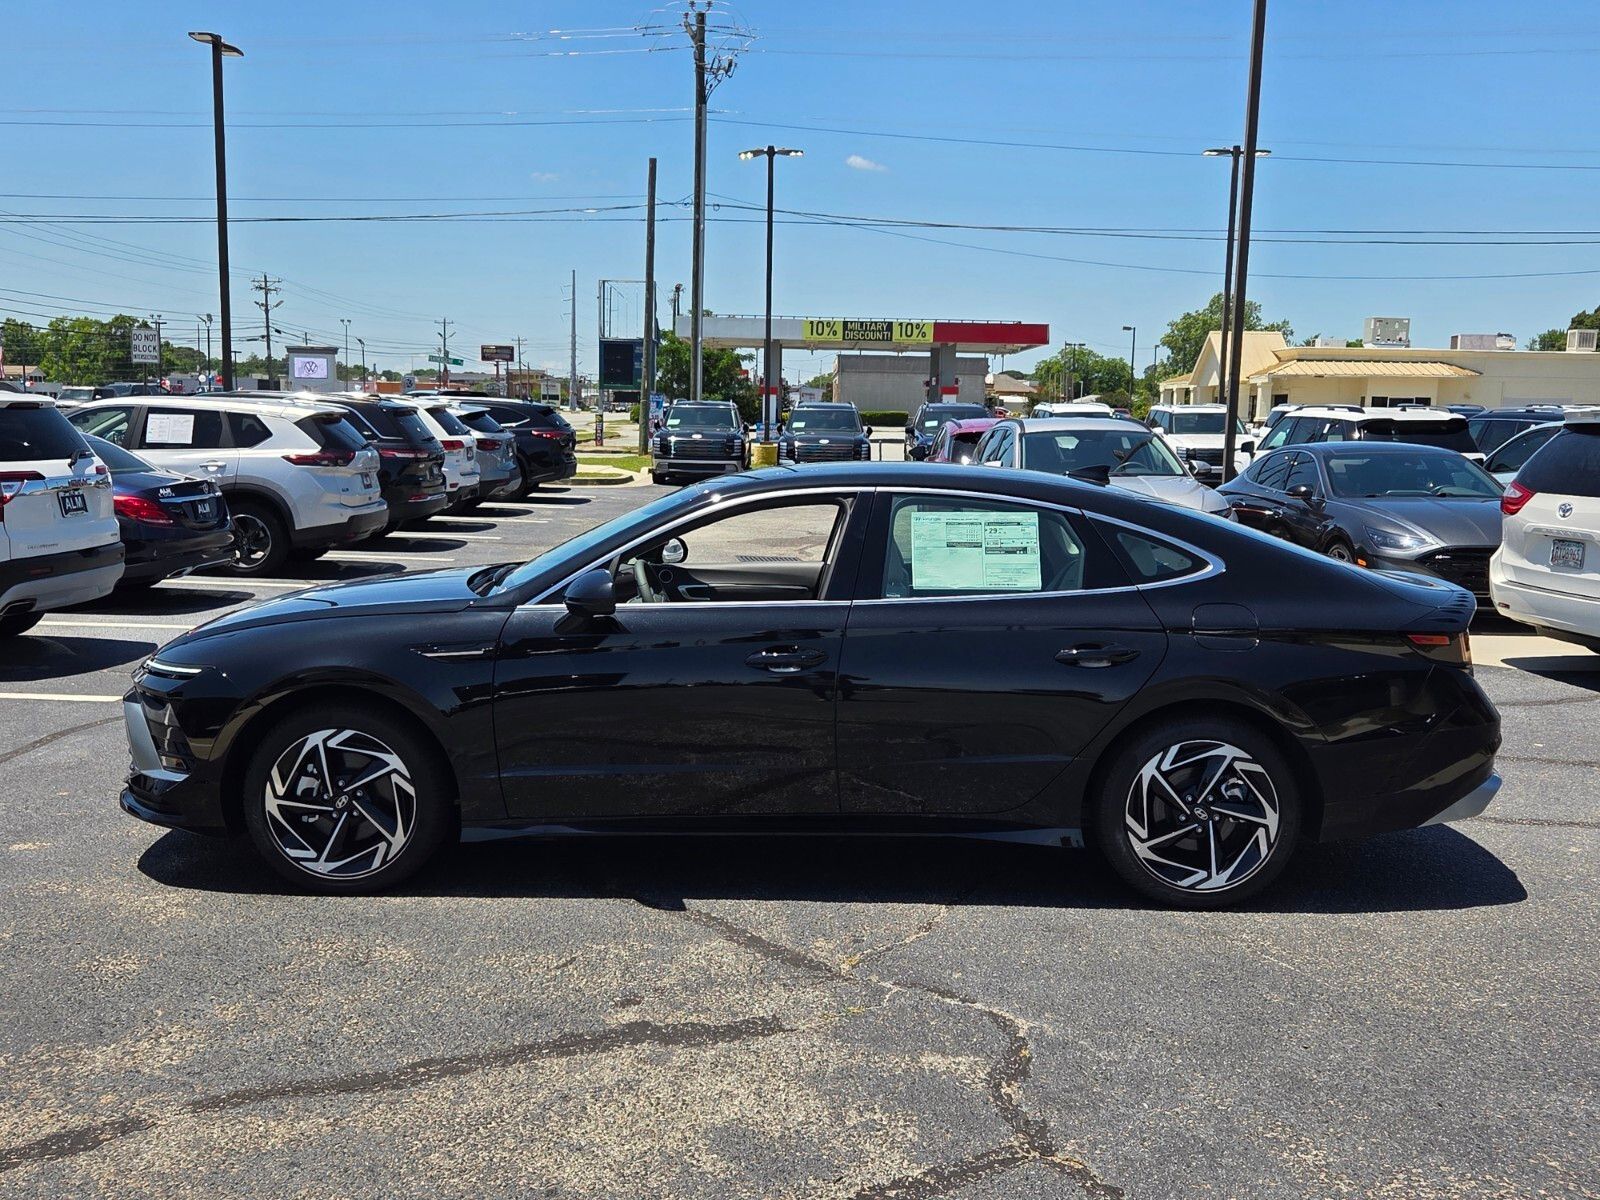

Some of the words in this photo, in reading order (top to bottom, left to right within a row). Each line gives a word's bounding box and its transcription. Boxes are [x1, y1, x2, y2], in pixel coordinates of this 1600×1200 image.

[809, 320, 838, 337] 10%
[847, 322, 888, 331] MILITARY
[898, 322, 927, 339] 10%
[133, 333, 142, 341] DO
[144, 333, 157, 341] NOT
[844, 331, 891, 341] DISCOUNT!
[133, 344, 157, 352] BLOCK
[64, 496, 84, 510] ALM
[197, 502, 211, 514] ALM
